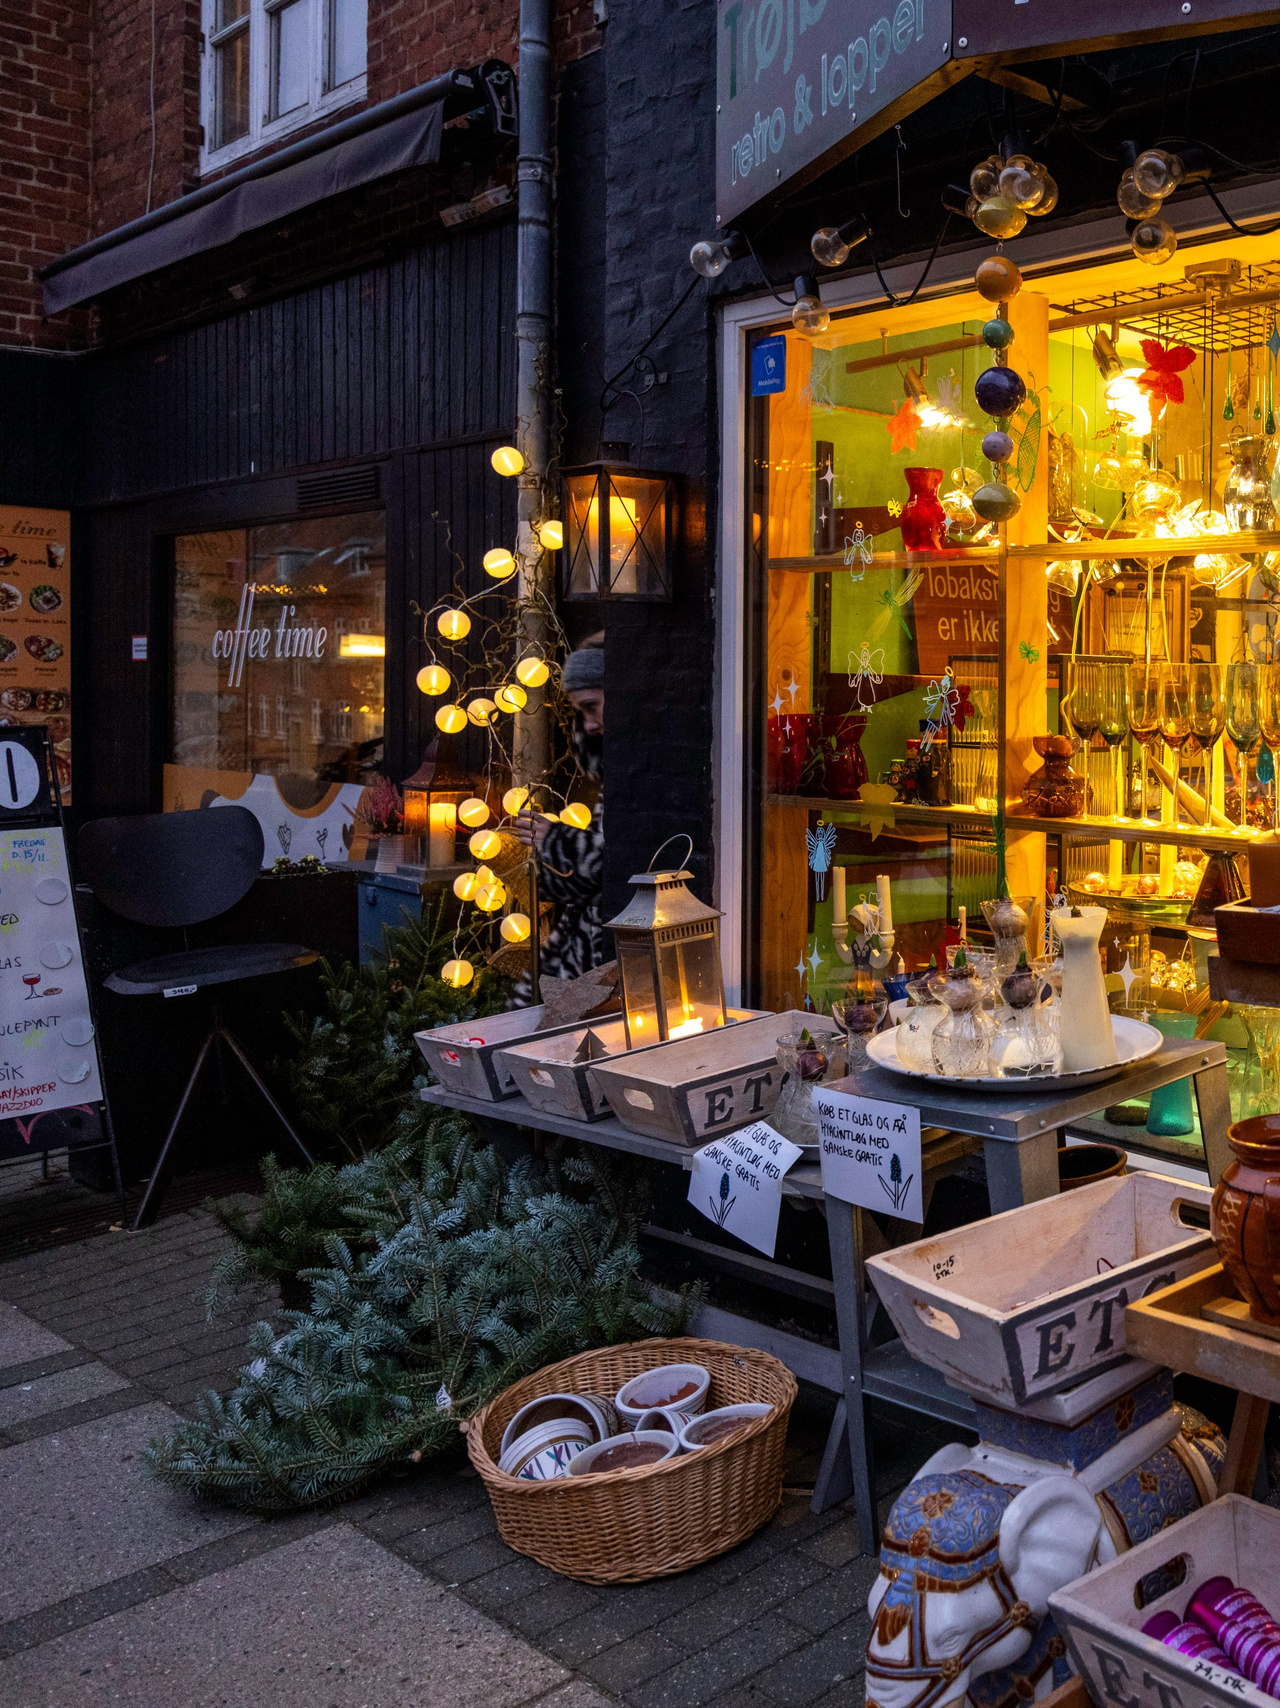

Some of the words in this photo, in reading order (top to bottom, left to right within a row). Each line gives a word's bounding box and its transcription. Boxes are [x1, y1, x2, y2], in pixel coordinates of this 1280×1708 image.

[731, 107, 786, 186] retro
[793, 74, 814, 135] &
[12, 519, 57, 536] time
[211, 582, 272, 688] coffee
[274, 604, 328, 658] time
[937, 616, 959, 641] er
[12, 839, 46, 849] FREDAG
[0, 913, 19, 926] ED
[0, 1097, 44, 1114] AZZDUO
[704, 1072, 790, 1129] ET
[817, 1100, 836, 1119] KØB
[838, 1107, 851, 1121] ET
[851, 1111, 874, 1127] GLAS
[876, 1115, 890, 1131] OG
[751, 1127, 771, 1147] GLAS
[768, 1139, 783, 1156] OG
[869, 1133, 890, 1150] MED
[703, 1144, 733, 1172] GANSKE
[933, 1254, 955, 1272] 10-15
